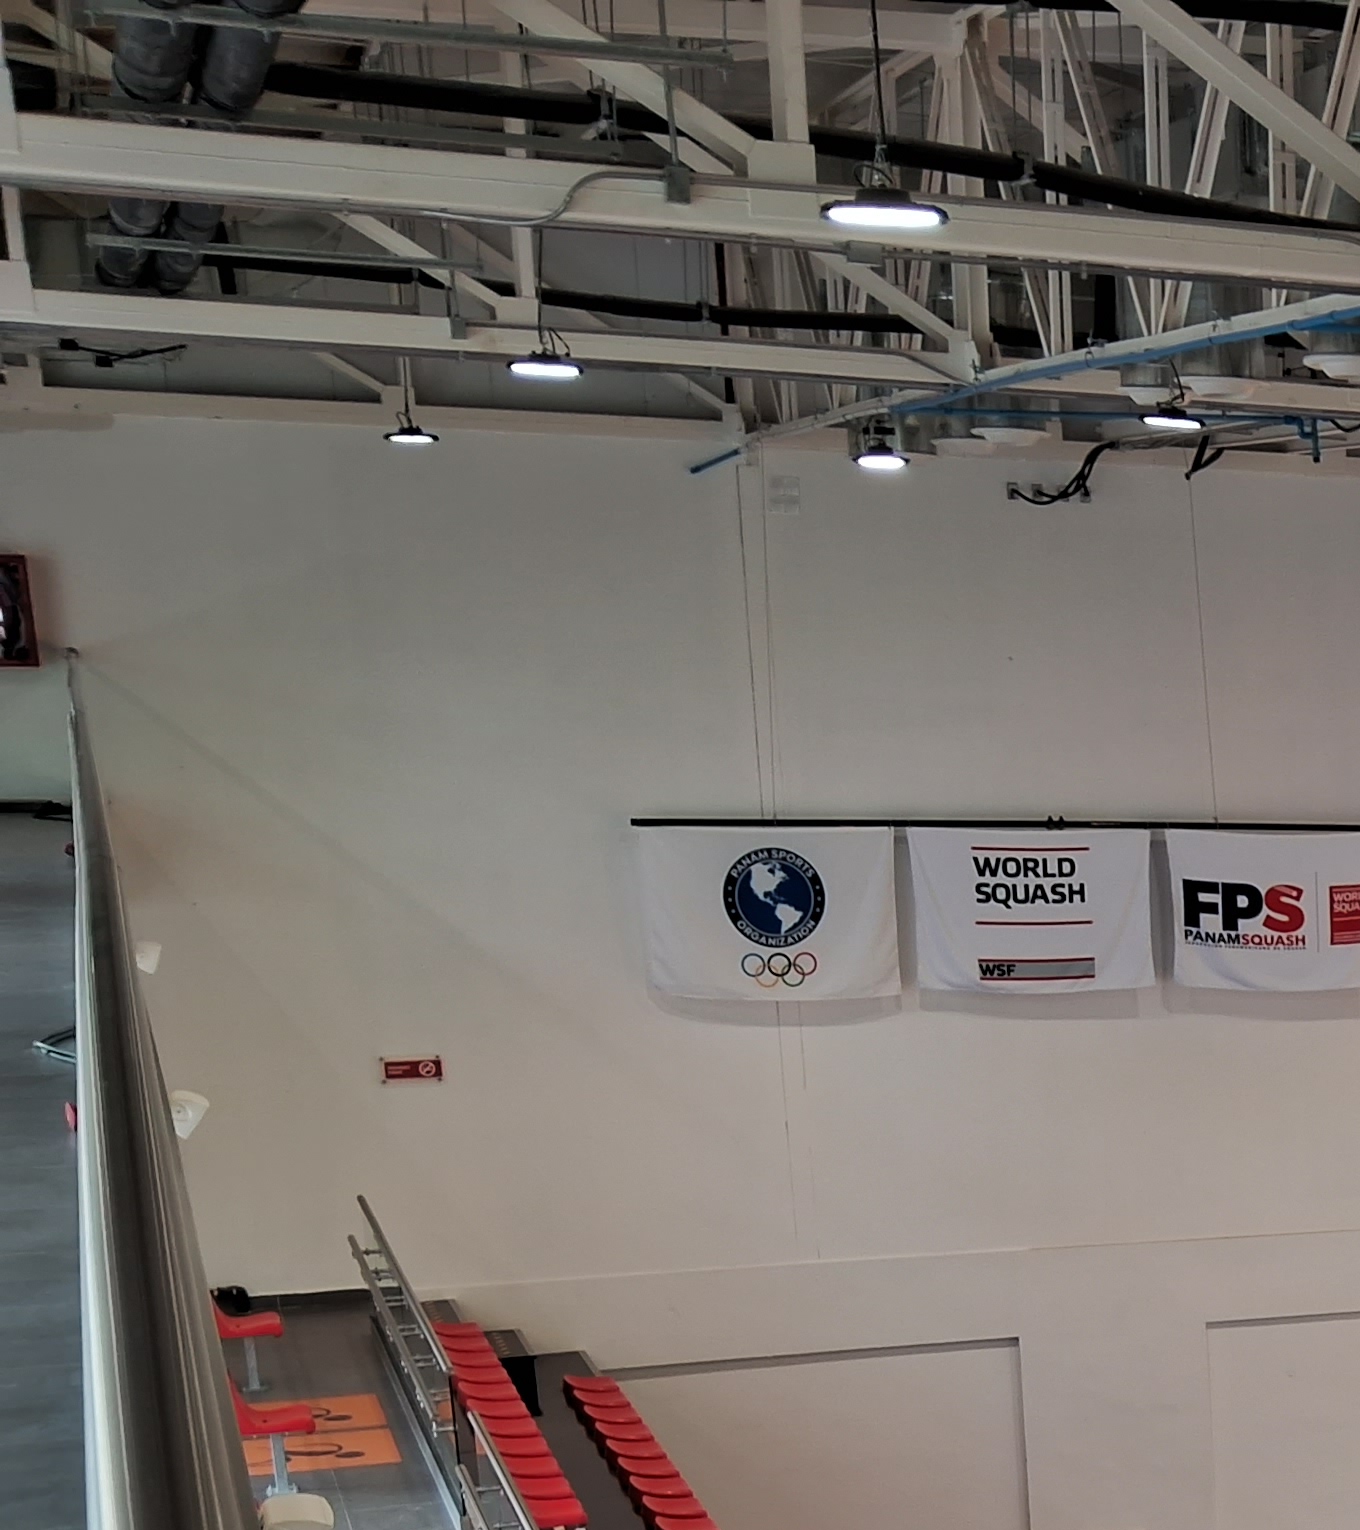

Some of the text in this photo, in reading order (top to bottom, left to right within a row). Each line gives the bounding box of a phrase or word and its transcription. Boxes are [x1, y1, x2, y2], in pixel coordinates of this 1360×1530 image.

[730, 849, 816, 878] PANAM SPORTS
[972, 856, 1076, 878] WORLD
[975, 882, 1086, 909] SQUASH
[1182, 878, 1305, 933] FPS
[736, 920, 816, 946] ORGANIZATION
[1184, 928, 1306, 947] PANAMSQUASH
[978, 963, 1016, 977] WSF
